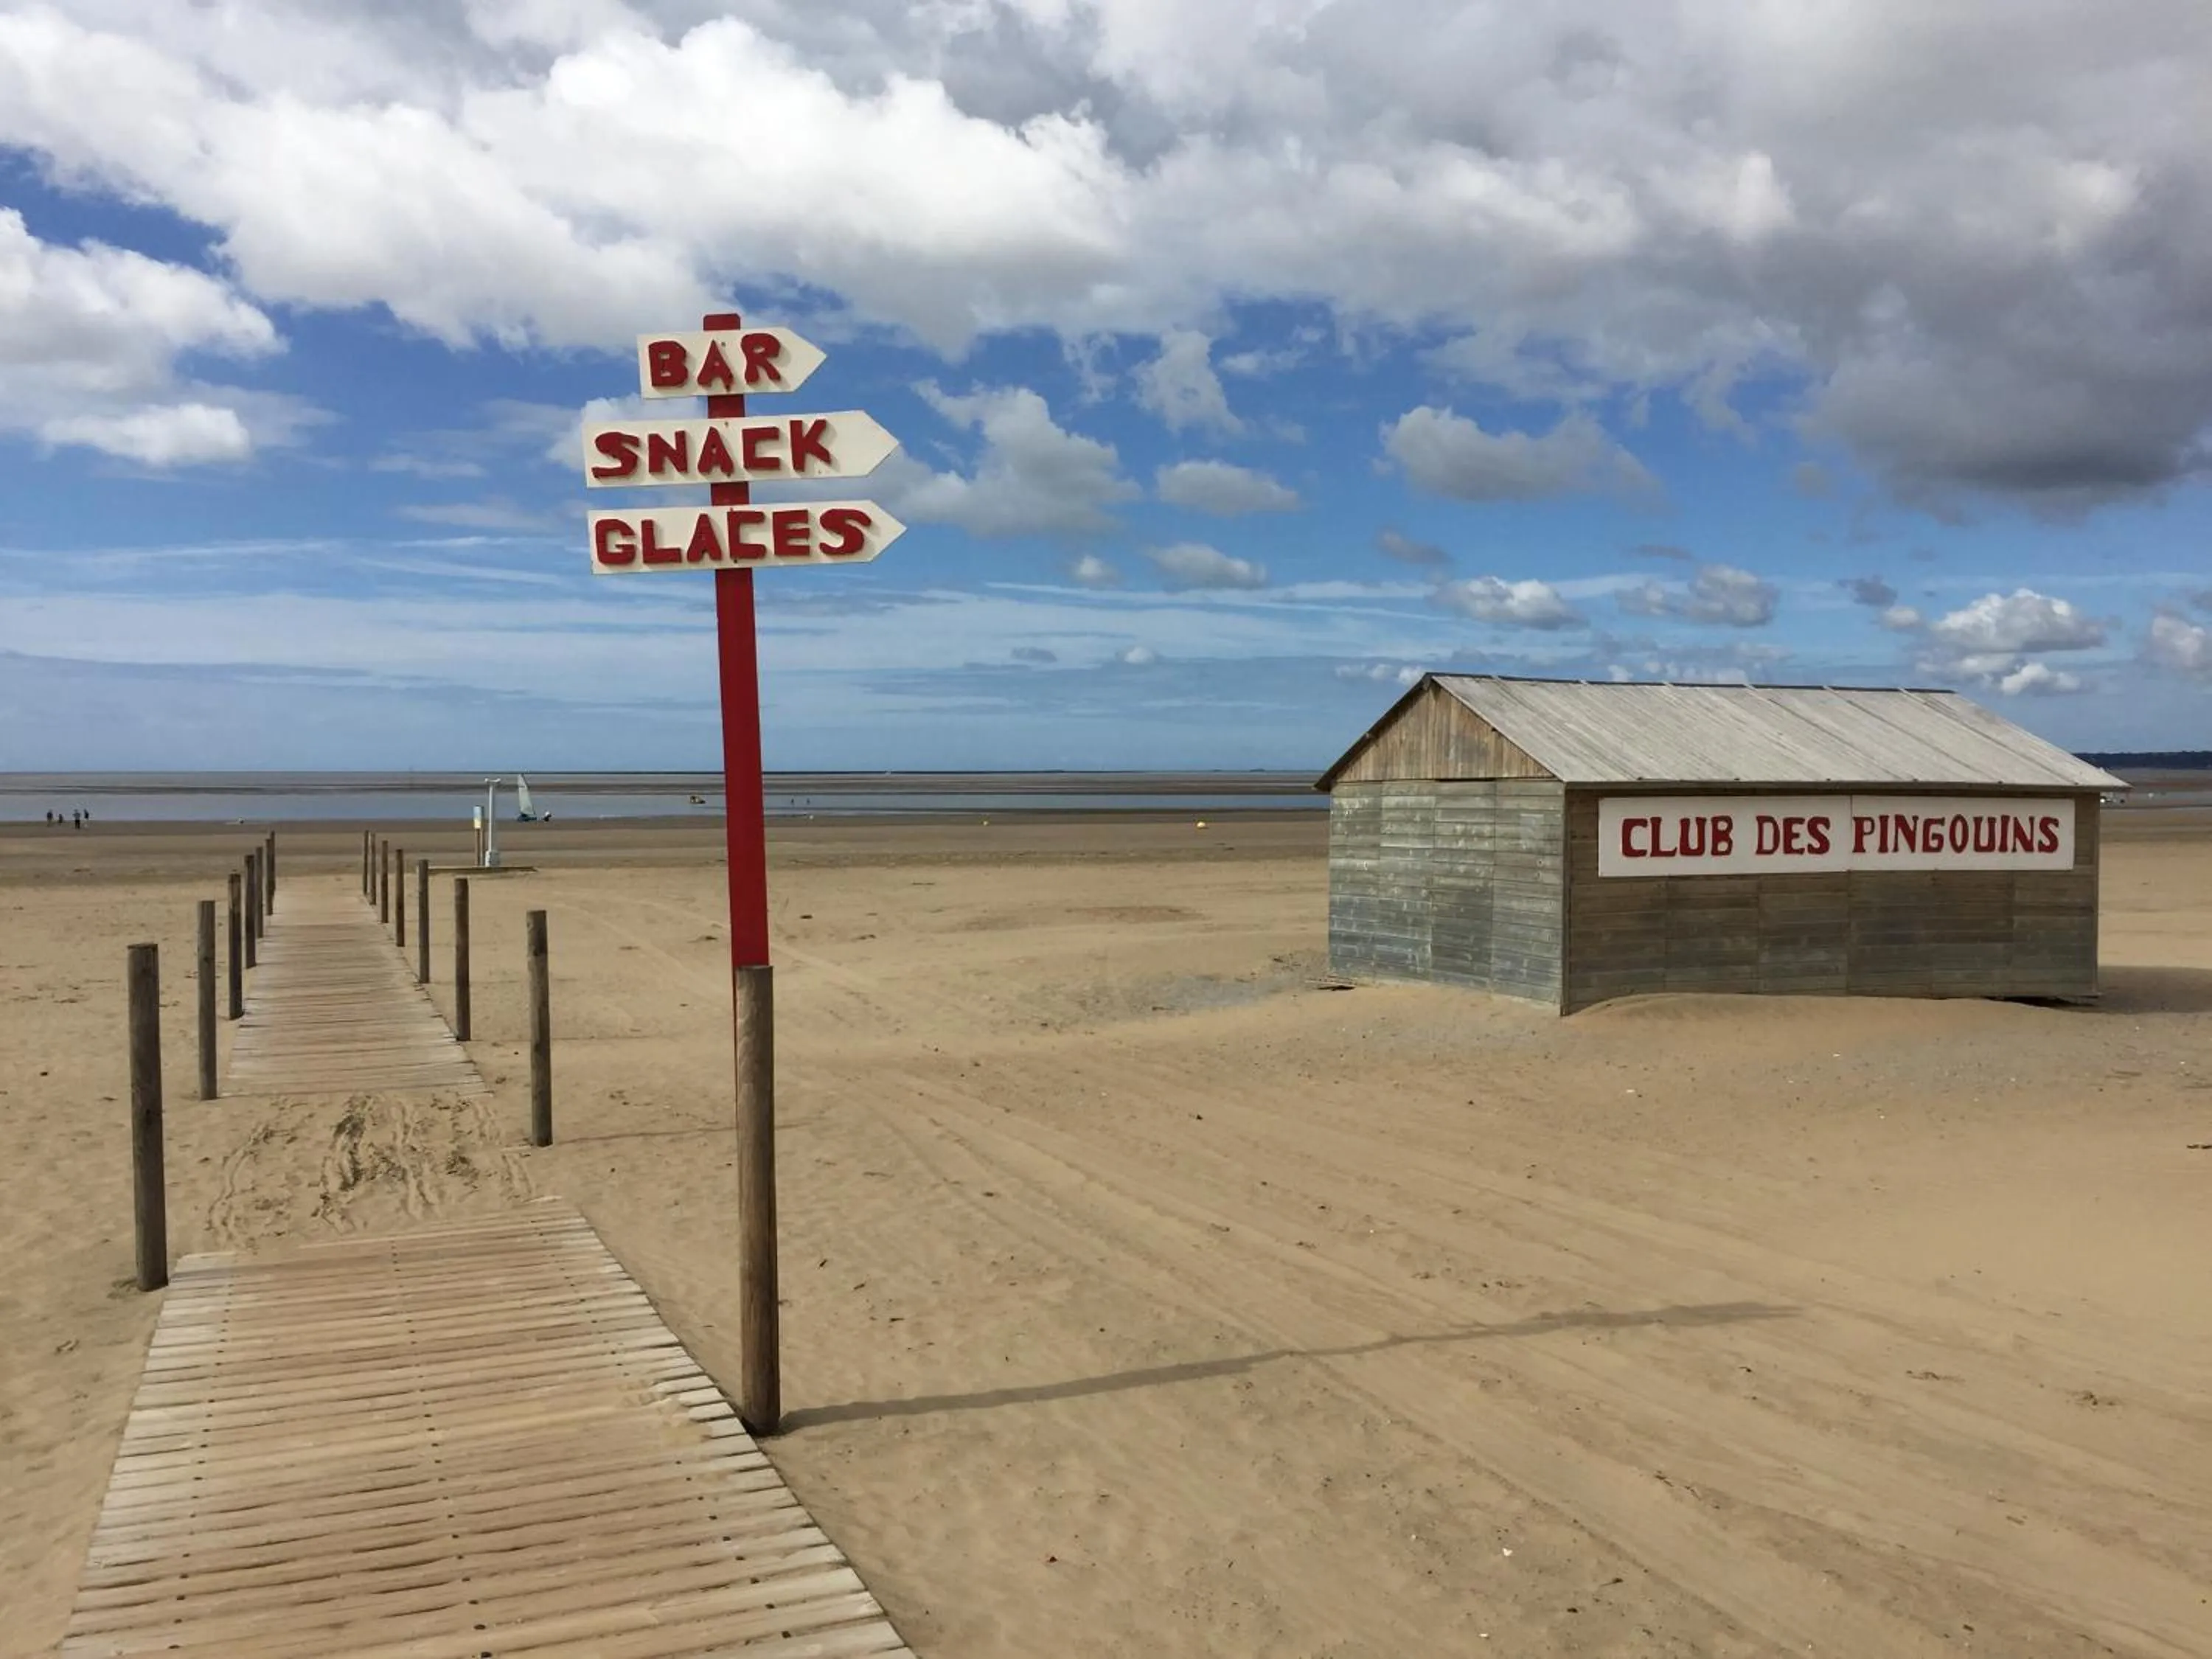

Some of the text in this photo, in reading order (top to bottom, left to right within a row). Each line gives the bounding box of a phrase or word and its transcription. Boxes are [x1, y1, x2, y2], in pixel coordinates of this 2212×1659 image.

[648, 333, 782, 388] BAR
[591, 419, 832, 479] SNACK
[595, 509, 872, 565] GLACES
[1621, 814, 2059, 857] CLUB DES PINGOUINS
